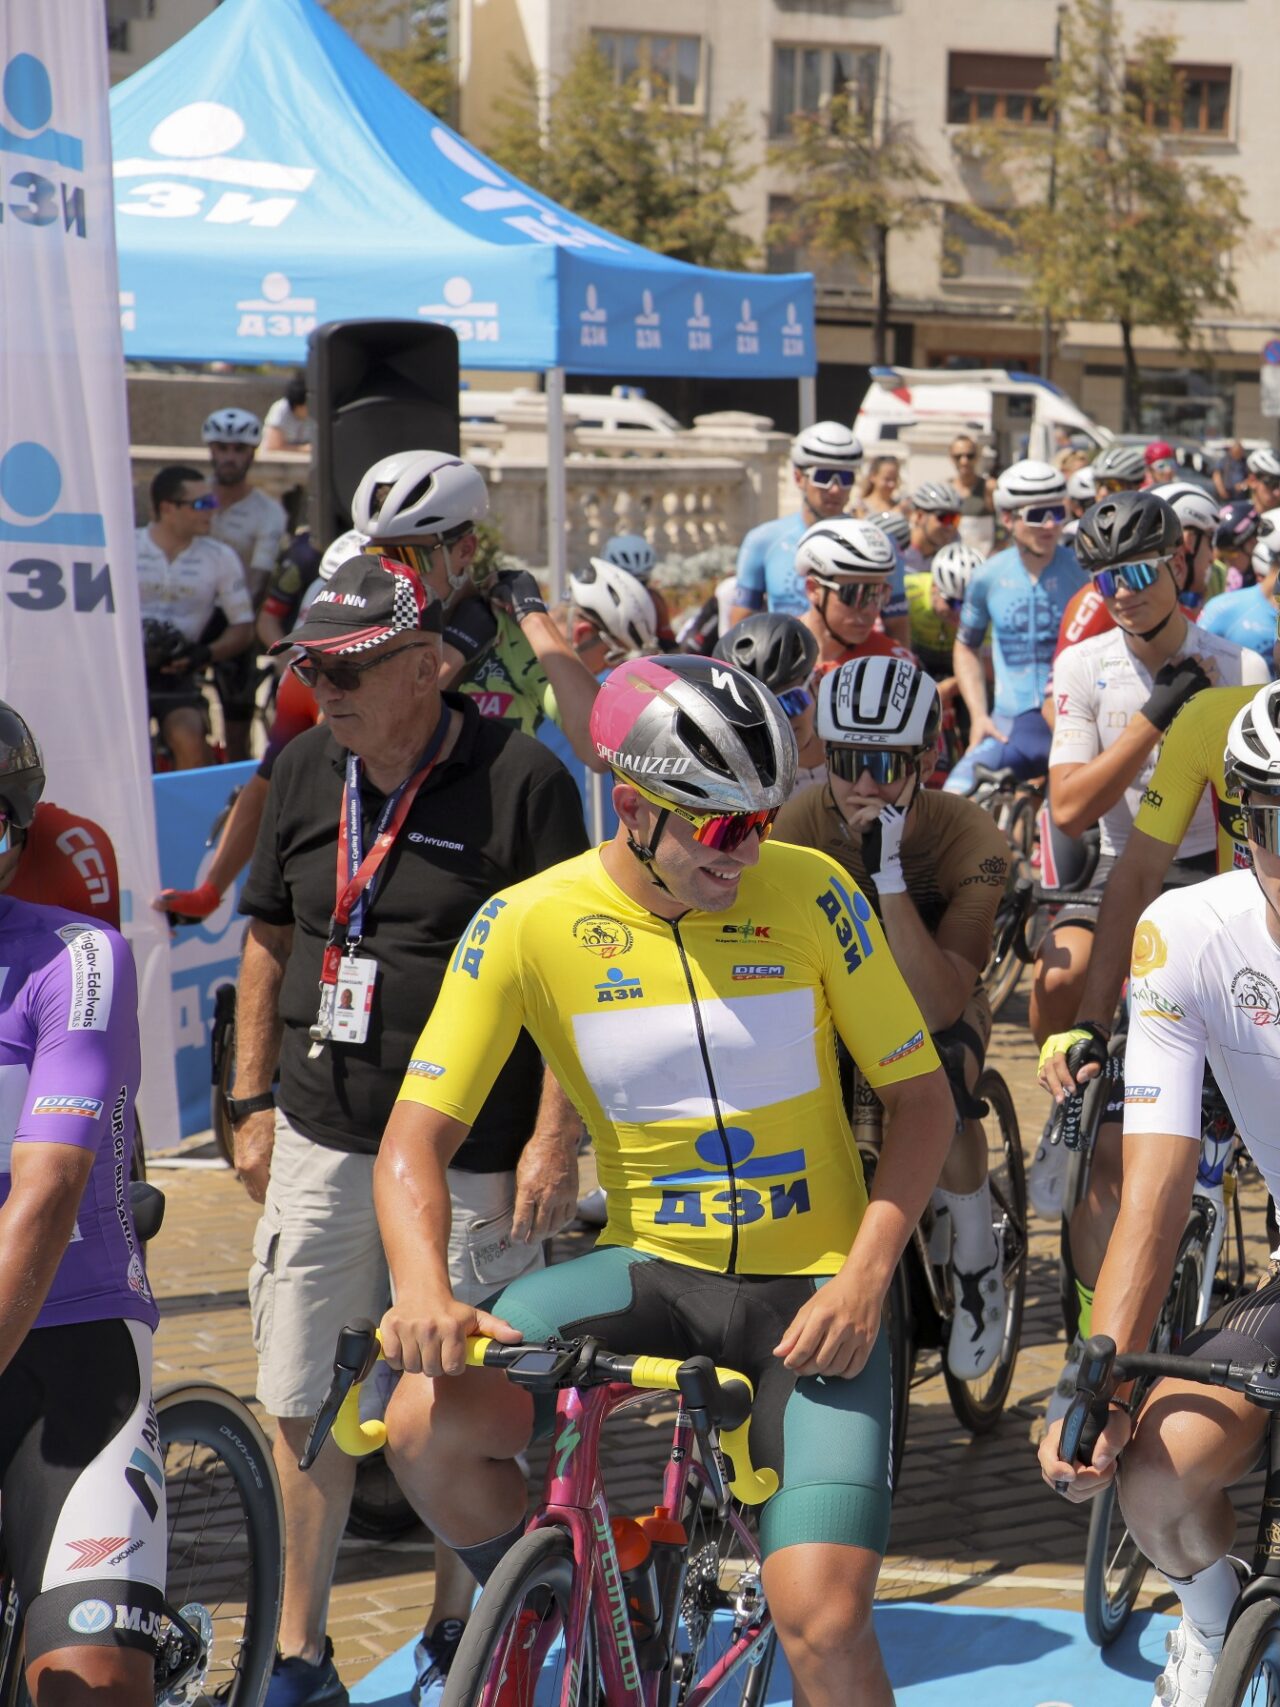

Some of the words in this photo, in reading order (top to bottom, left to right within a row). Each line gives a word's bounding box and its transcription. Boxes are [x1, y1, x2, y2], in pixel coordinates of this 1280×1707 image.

[0, 170, 87, 240] ЗИ
[116, 181, 298, 228] ЗИ
[236, 314, 318, 337] ДЗИ
[891, 662, 913, 712] FORCE
[843, 732, 890, 743] FORCE
[596, 742, 691, 776] SPECIALIZED
[351, 835, 359, 859] Cycling
[424, 836, 465, 852] HYUNDAI
[461, 896, 509, 980] ДЗИ
[815, 889, 862, 975] ДЗИ
[735, 966, 782, 975] DIEM
[597, 987, 644, 1003] ДЗИ
[40, 1097, 98, 1109] DIEM
[112, 1086, 127, 1136] TOUR
[113, 1136, 124, 1162] OF
[653, 1177, 812, 1228] ДЗИ
[218, 1425, 264, 1489] DURA-ACE
[106, 1539, 146, 1567] YOKOHAMA
